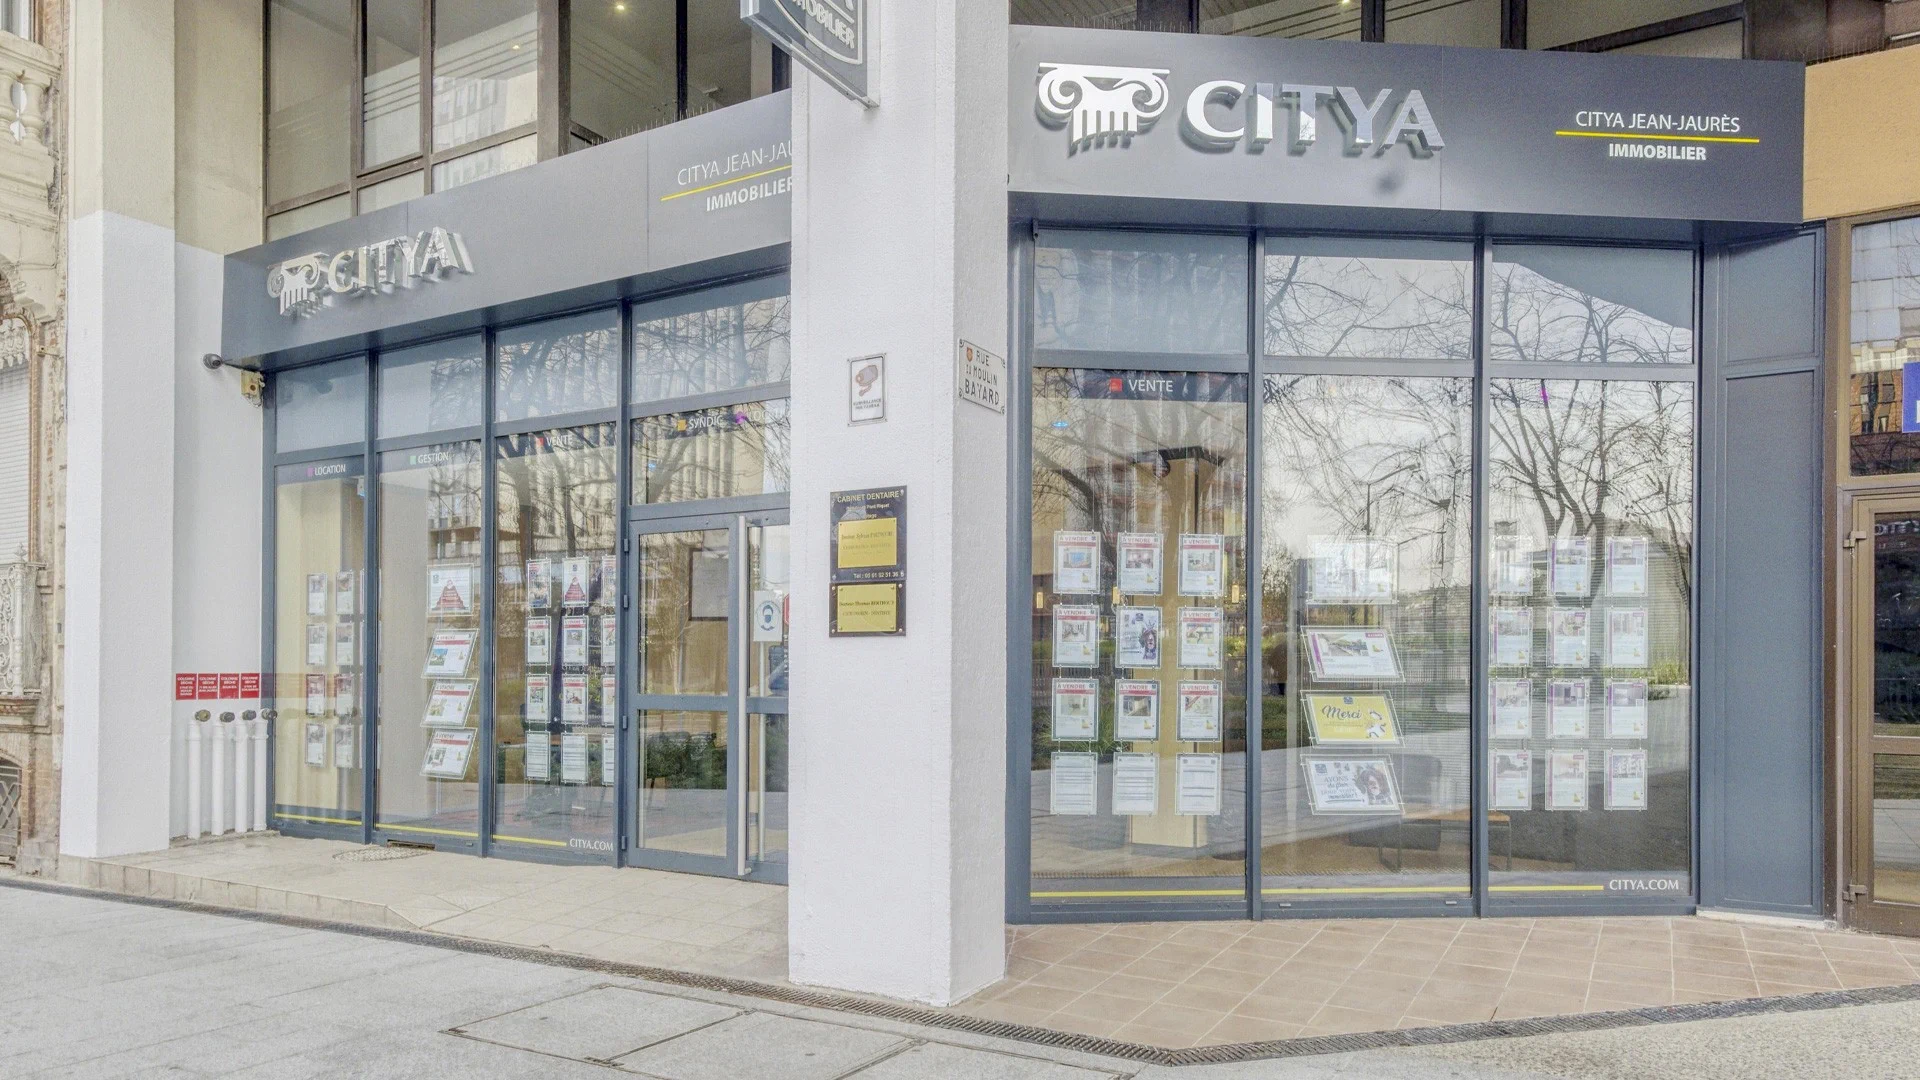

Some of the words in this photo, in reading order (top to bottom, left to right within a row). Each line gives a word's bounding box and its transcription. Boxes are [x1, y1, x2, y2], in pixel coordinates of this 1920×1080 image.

[1186, 79, 1445, 151] CITYA
[1576, 110, 1624, 128] CITYA
[1628, 114, 1740, 133] JEAN-JAURÈS
[1609, 143, 1706, 160] IMMOBILIER
[677, 160, 720, 186] CITYA
[328, 226, 460, 294] CITYA
[976, 350, 989, 366] RUE
[973, 365, 998, 386] MOULIN
[965, 378, 1000, 405] BAYARD
[1128, 379, 1174, 392] VENTE
[688, 416, 723, 430] SYNDIC
[546, 434, 573, 446] VENTE
[418, 452, 448, 464] GESTION
[314, 464, 346, 476] LOCATION
[838, 493, 865, 503] CABINET
[866, 490, 900, 500] DENTAIRE
[1322, 704, 1362, 720] Merci
[570, 838, 613, 851] CITYA.COM
[1609, 880, 1679, 890] CITYA.COM
